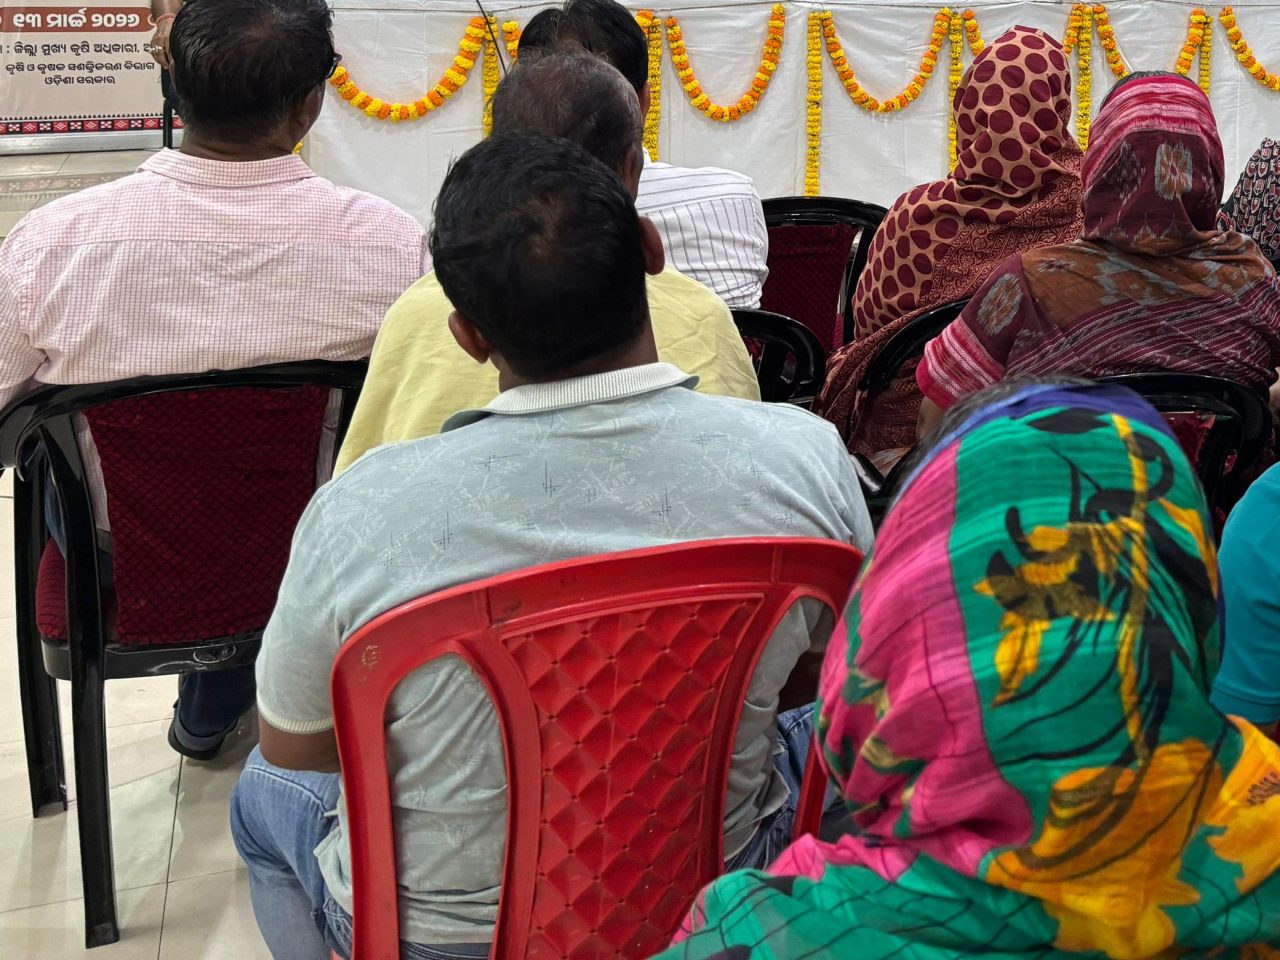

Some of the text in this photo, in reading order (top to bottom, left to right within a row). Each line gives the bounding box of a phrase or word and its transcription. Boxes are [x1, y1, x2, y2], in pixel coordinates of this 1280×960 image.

[12, 13, 41, 28] ୧୩
[91, 13, 140, 28] ୨୦୨୬
[14, 41, 38, 56] ଜିଲ୍ଲା
[41, 44, 67, 56] ମୁଖ୍ୟ
[70, 41, 90, 56] କୃଷି
[5, 62, 25, 75] କୃଷି
[37, 63, 65, 74] କୃଷକ
[124, 61, 155, 70] ବିଭାଗ
[45, 75, 116, 86] ଓଡ଼ିଶା ସରକାର
